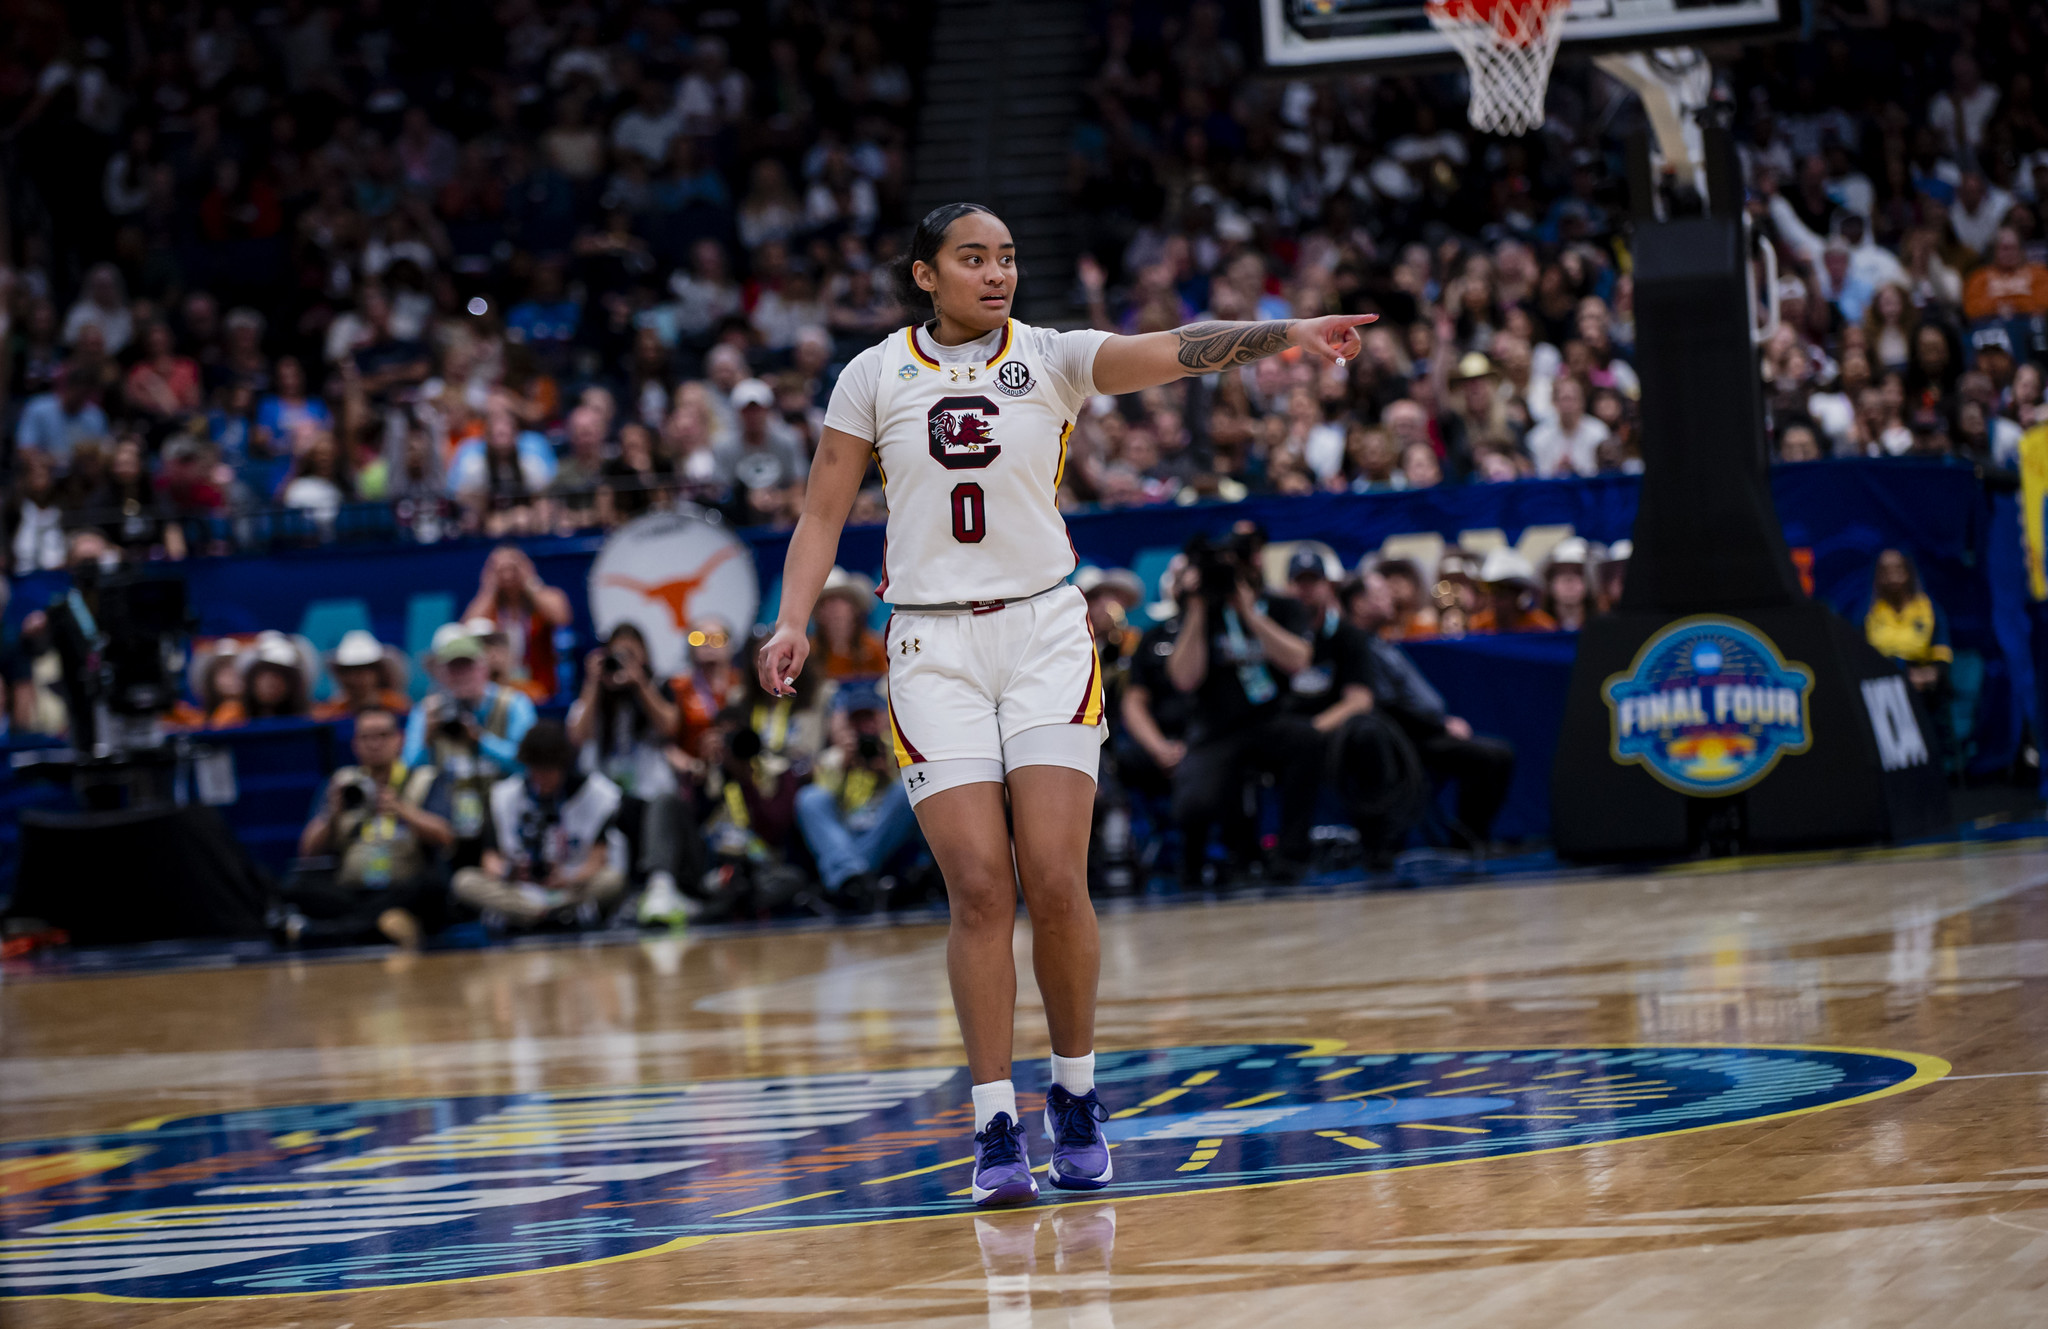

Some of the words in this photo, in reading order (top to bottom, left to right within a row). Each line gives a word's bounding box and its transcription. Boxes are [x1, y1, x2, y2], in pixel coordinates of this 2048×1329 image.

[999, 384, 1031, 396] GRADUATE
[1001, 362, 1027, 387] SEC
[928, 395, 1002, 470] C
[951, 482, 986, 543] 0
[1620, 685, 1709, 738] FINAL
[1713, 683, 1800, 727] FOUR
